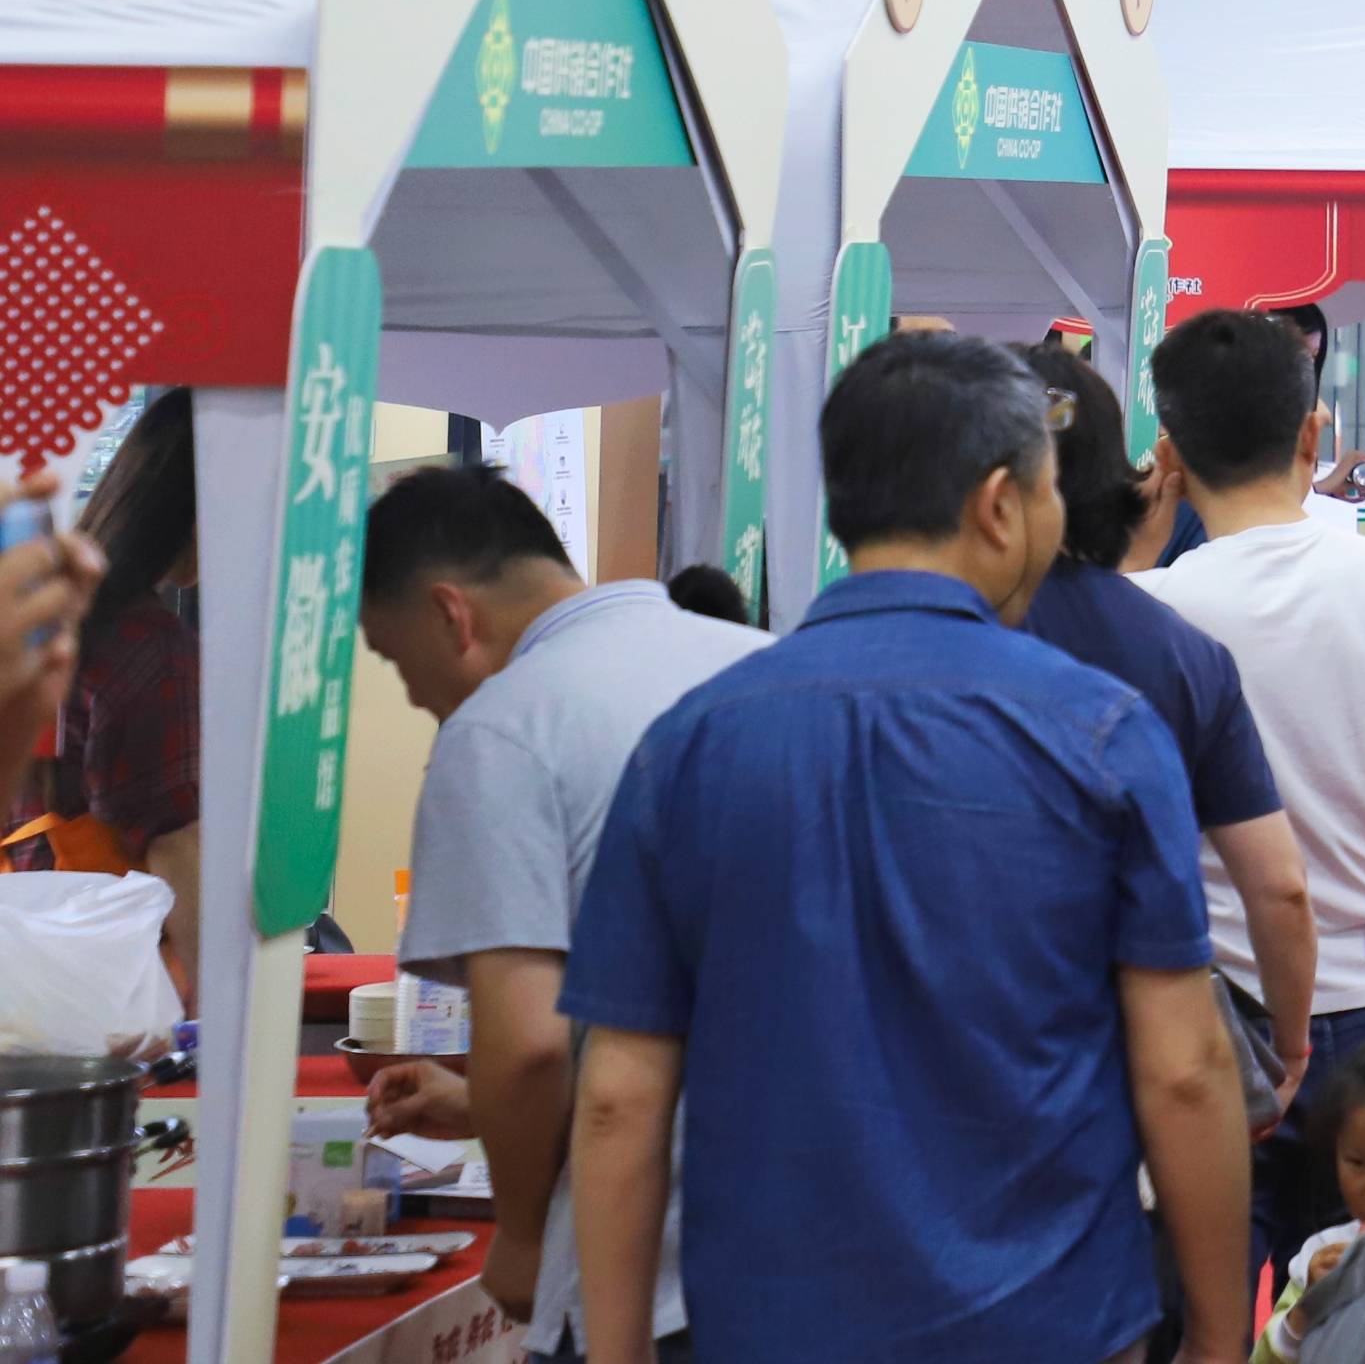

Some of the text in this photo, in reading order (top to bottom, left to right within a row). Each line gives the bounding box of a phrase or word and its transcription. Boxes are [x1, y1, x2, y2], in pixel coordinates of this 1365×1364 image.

[985, 85, 1062, 132] 中国供销合作社
[997, 138, 1018, 158] CHINA
